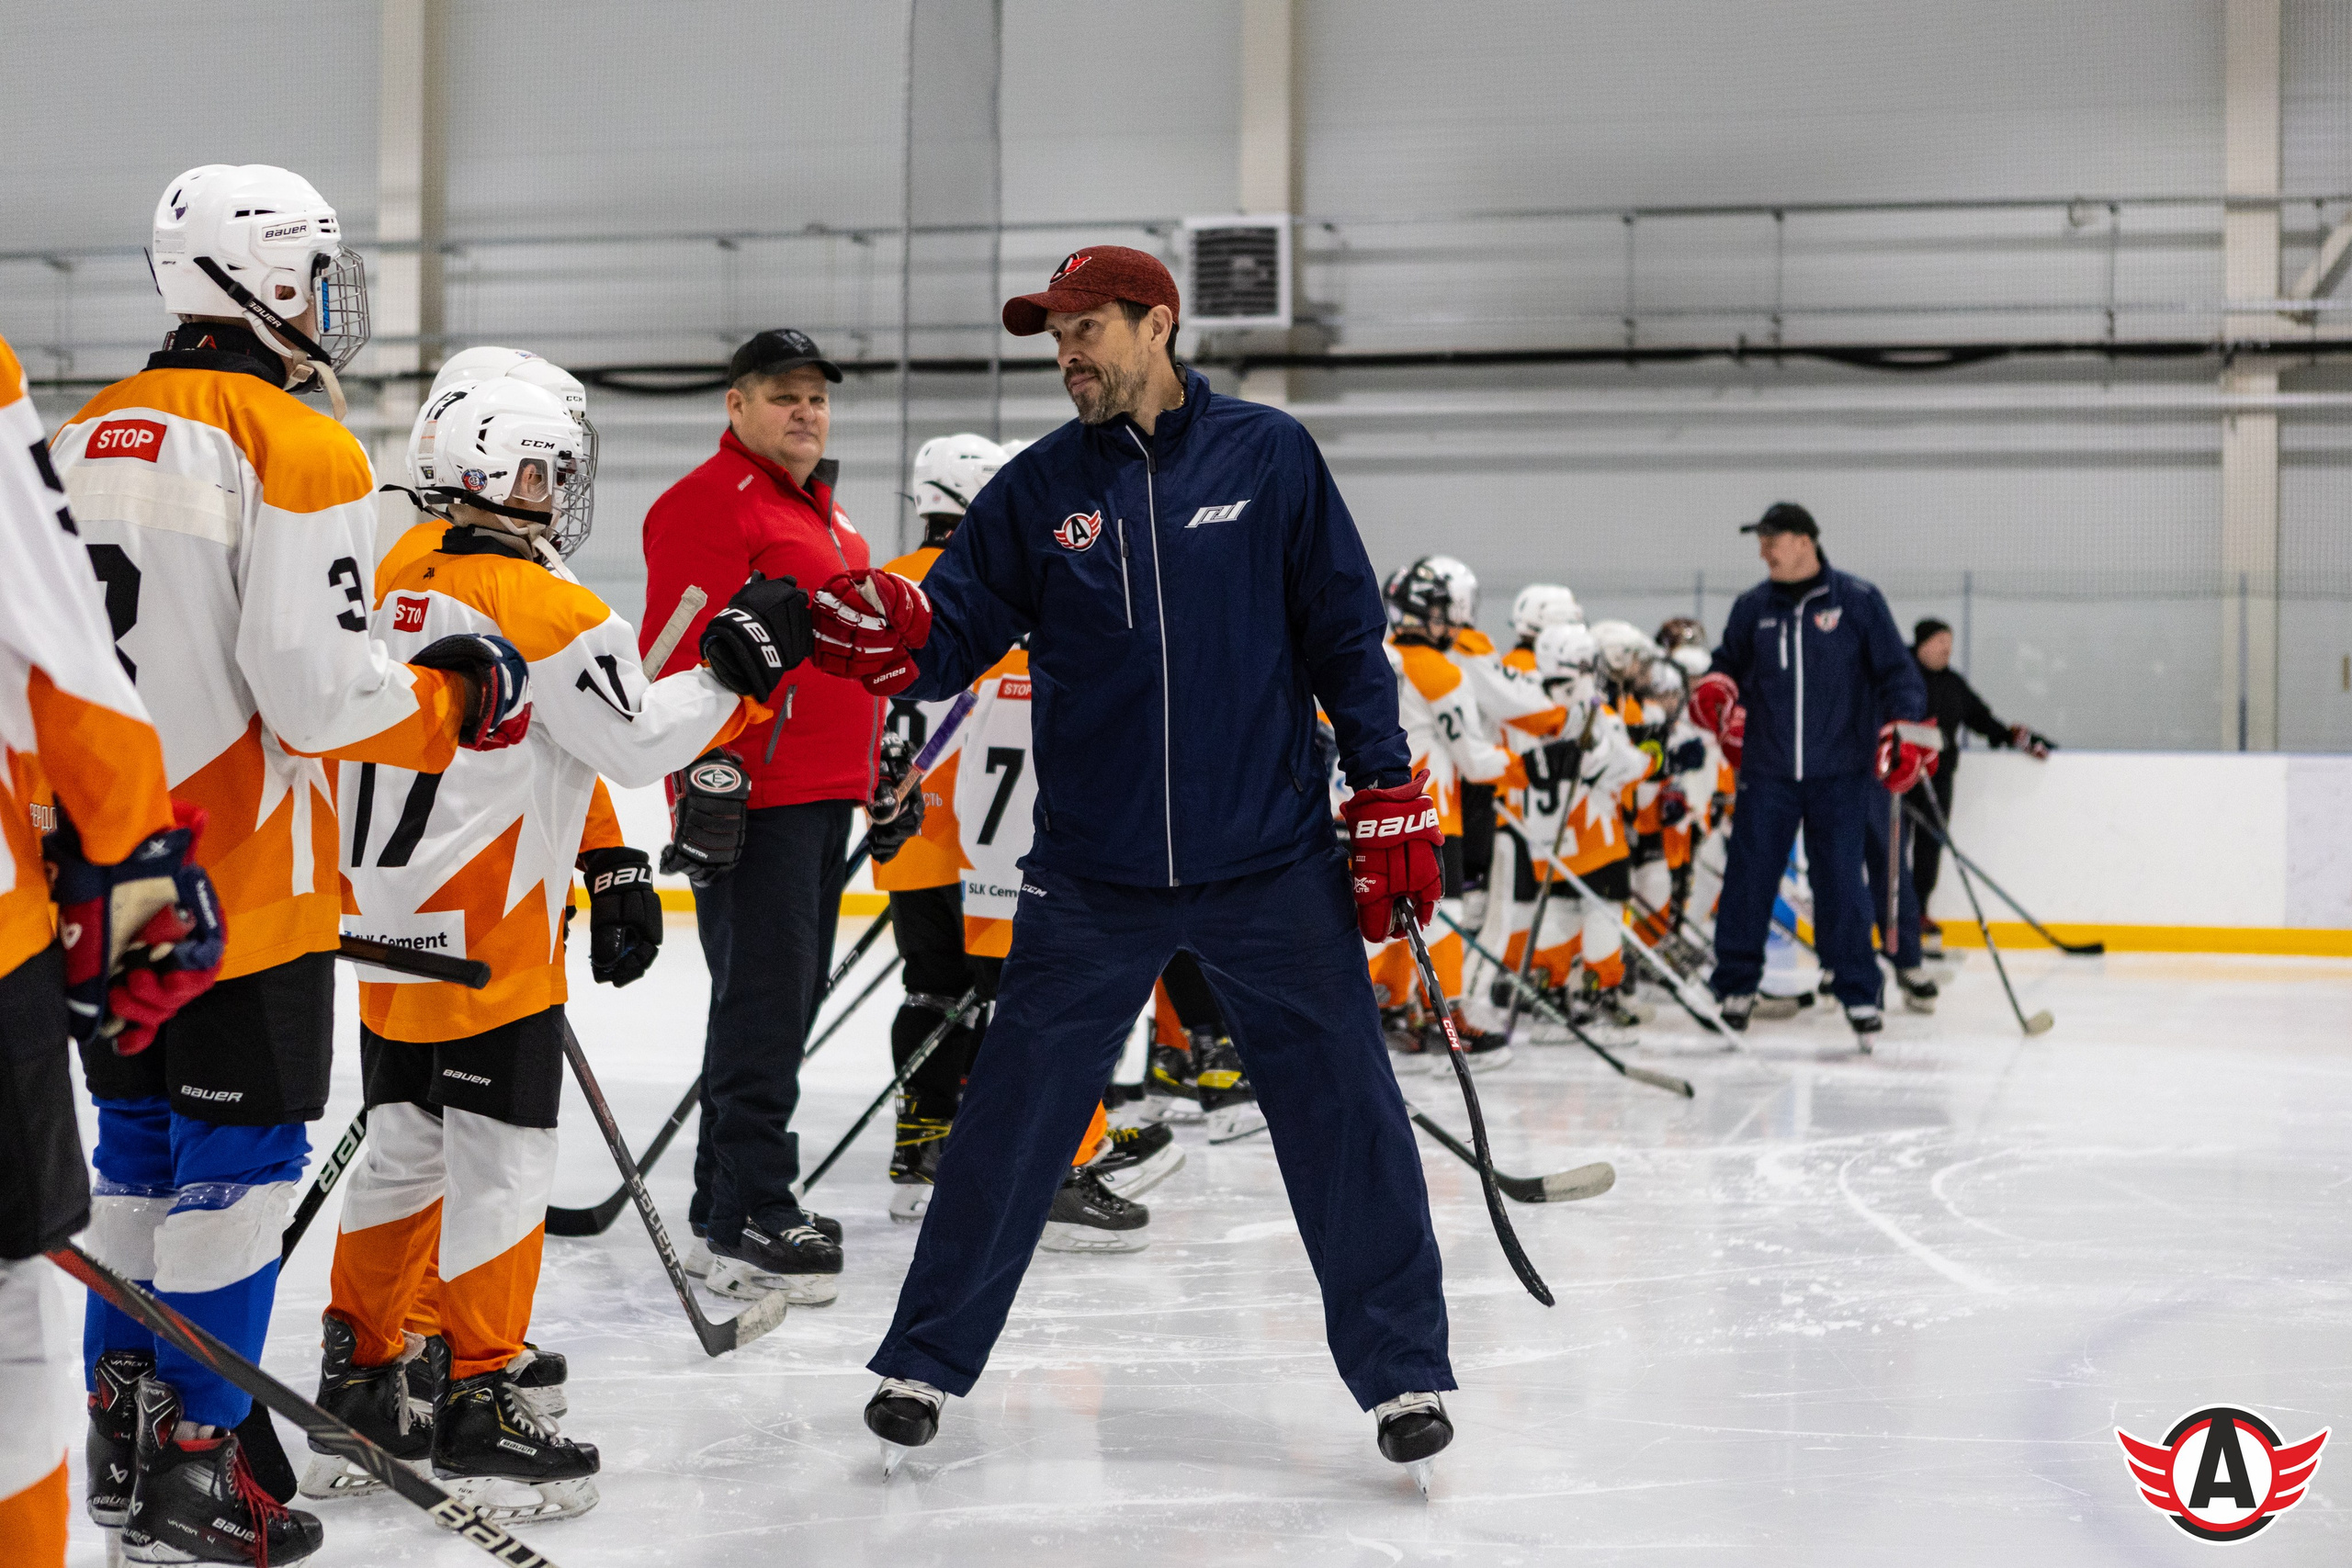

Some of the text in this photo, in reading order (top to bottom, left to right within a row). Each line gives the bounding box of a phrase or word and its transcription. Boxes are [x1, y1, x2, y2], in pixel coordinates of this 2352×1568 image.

[265, 224, 307, 239] BAUER
[96, 428, 155, 449] STOP
[520, 438, 556, 450] CCM
[328, 556, 368, 633] 3
[395, 603, 424, 626] STO
[873, 667, 907, 684] BAUER
[976, 746, 1026, 846] 7
[682, 842, 709, 859] EASTON
[968, 883, 1019, 898] SLK Cem
[1022, 883, 1048, 898] CCM
[1442, 1019, 1459, 1049] CCM
[442, 1068, 492, 1087] BAUER
[181, 1085, 243, 1103] BAUER
[211, 1517, 256, 1543] BAUE
